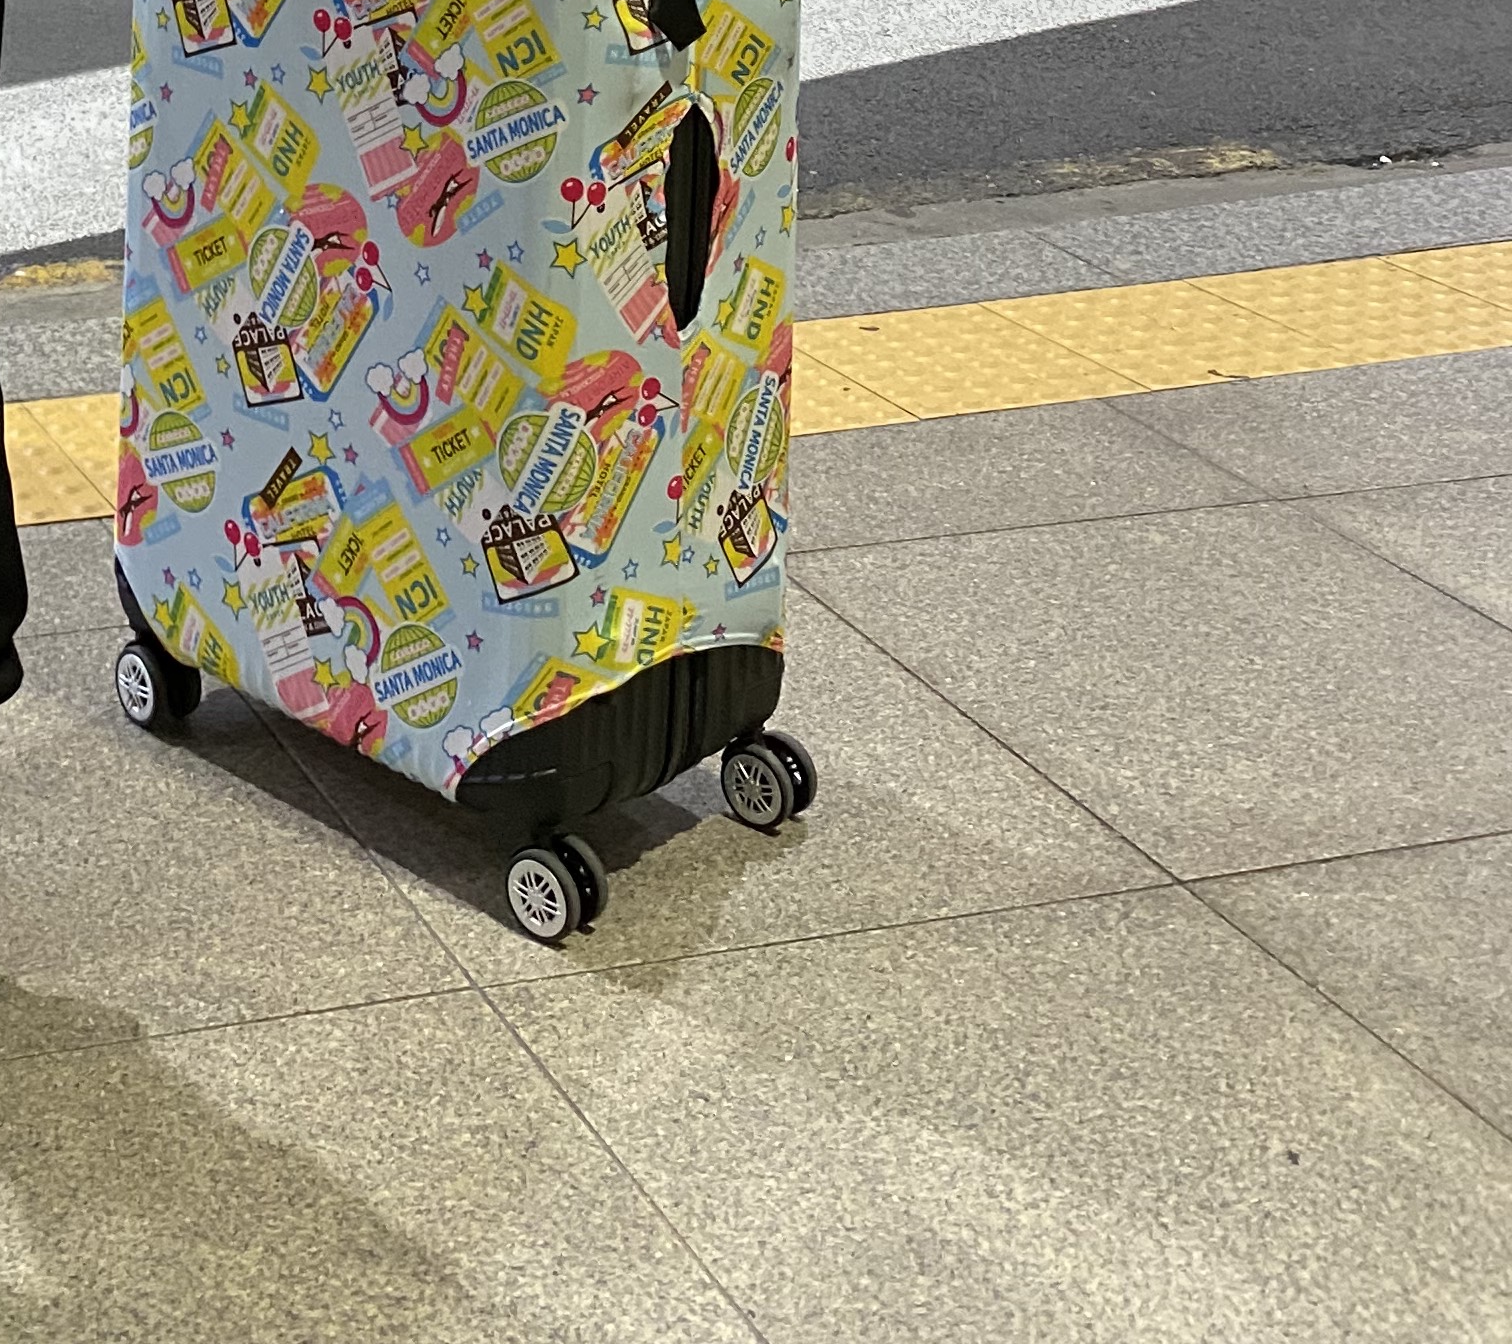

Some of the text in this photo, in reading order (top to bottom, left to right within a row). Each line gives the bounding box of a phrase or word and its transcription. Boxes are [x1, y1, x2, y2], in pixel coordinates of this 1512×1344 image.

[337, 60, 381, 93] YOUTH
[496, 29, 546, 77] ICN
[731, 33, 766, 86] ICN
[467, 126, 509, 160] SANTA
[508, 105, 566, 142] MONICA
[625, 92, 666, 138] TRAVEL
[272, 119, 305, 178] HND
[193, 237, 228, 267] TICKET
[281, 228, 310, 272] SANTA
[590, 216, 632, 260] YOUTH
[259, 269, 292, 324] MONICA
[747, 276, 775, 340] HND
[516, 300, 550, 361] HND
[159, 366, 196, 407] ICN
[753, 375, 777, 426] SANTA
[431, 428, 472, 464] TICKET
[542, 408, 582, 458] SANTA
[145, 443, 219, 478] SANTA MONICA
[738, 427, 762, 490] MONICA
[445, 469, 483, 517] YOUTH
[512, 455, 558, 515] MONICA
[688, 471, 717, 531] YOUTH
[484, 513, 552, 544] PALACE
[338, 531, 364, 576] ICKET
[249, 584, 289, 611] YOUTH
[394, 573, 437, 621] ICN
[637, 606, 666, 666] HND
[375, 648, 464, 703] SANTA MONICA
